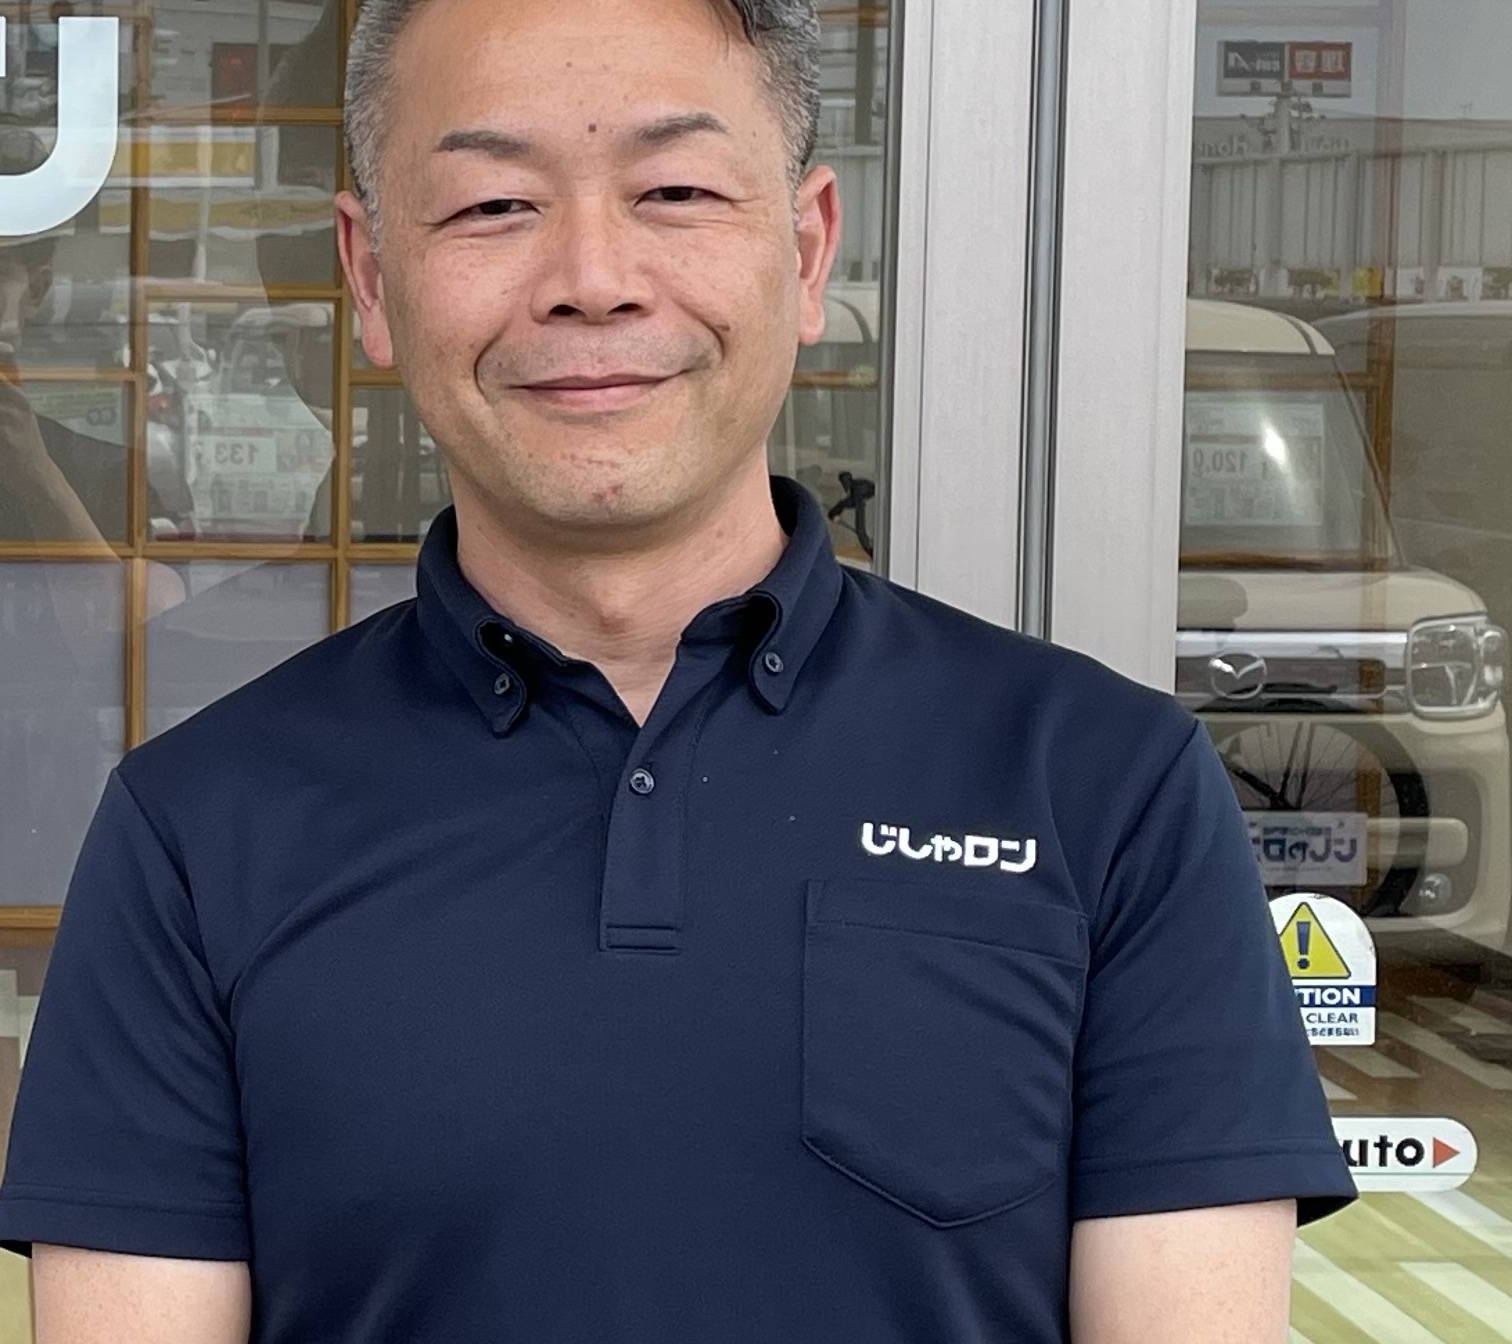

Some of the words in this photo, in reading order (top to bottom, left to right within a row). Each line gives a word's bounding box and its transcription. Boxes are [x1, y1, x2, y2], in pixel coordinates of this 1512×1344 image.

[861, 821, 1037, 874] じしゃロン
[1294, 987, 1361, 1006] TION
[1305, 1012, 1359, 1024] CLEAR
[1342, 1134, 1426, 1167] uto
